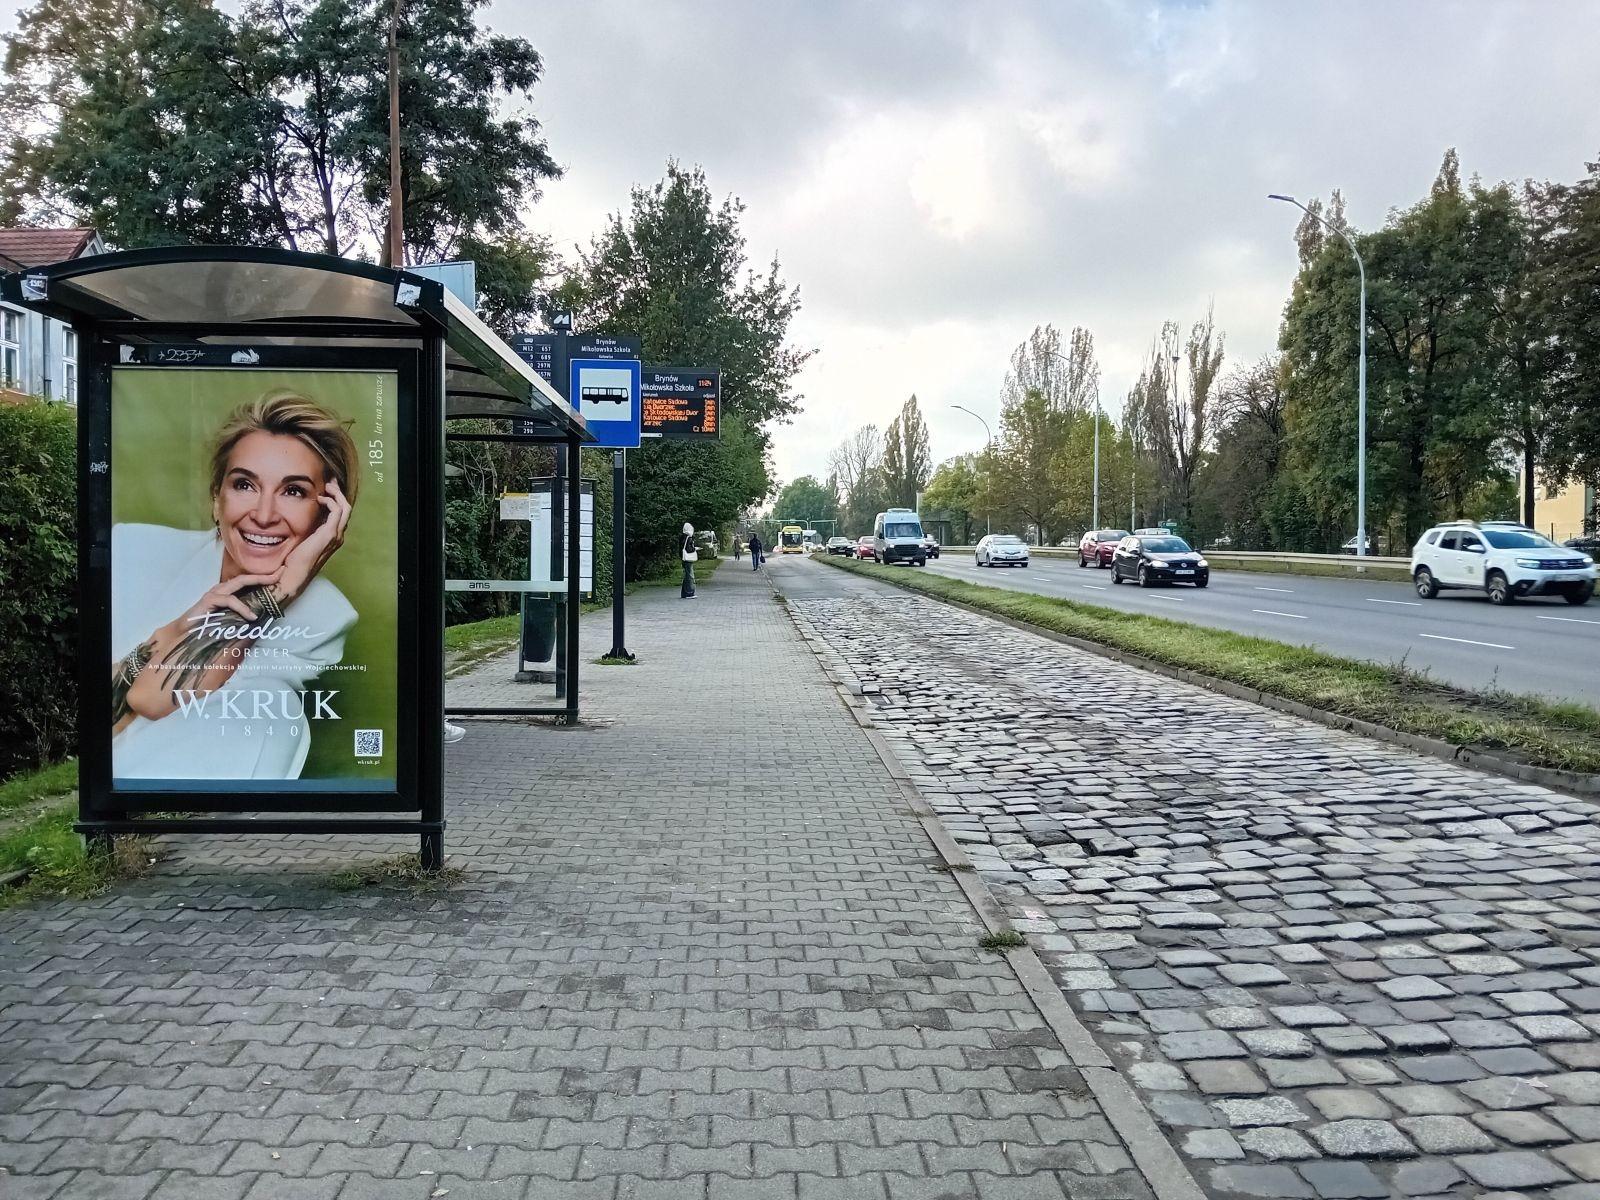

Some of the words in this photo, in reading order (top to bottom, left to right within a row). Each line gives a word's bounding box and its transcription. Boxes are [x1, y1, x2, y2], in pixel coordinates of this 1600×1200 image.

[595, 338, 617, 346] Brynów
[655, 374, 678, 383] Brynów
[641, 383, 673, 391] Mikołowska
[376, 408, 383, 420] na
[373, 422, 383, 435] lat
[368, 440, 383, 467] 185
[374, 471, 384, 483] od
[187, 611, 326, 641] Freedom
[223, 647, 290, 658] FOREVER
[203, 663, 235, 672] kolekcja
[304, 664, 368, 672] Wojciechowskiej
[172, 689, 342, 720] W.KRUK
[219, 725, 298, 736] 1840
